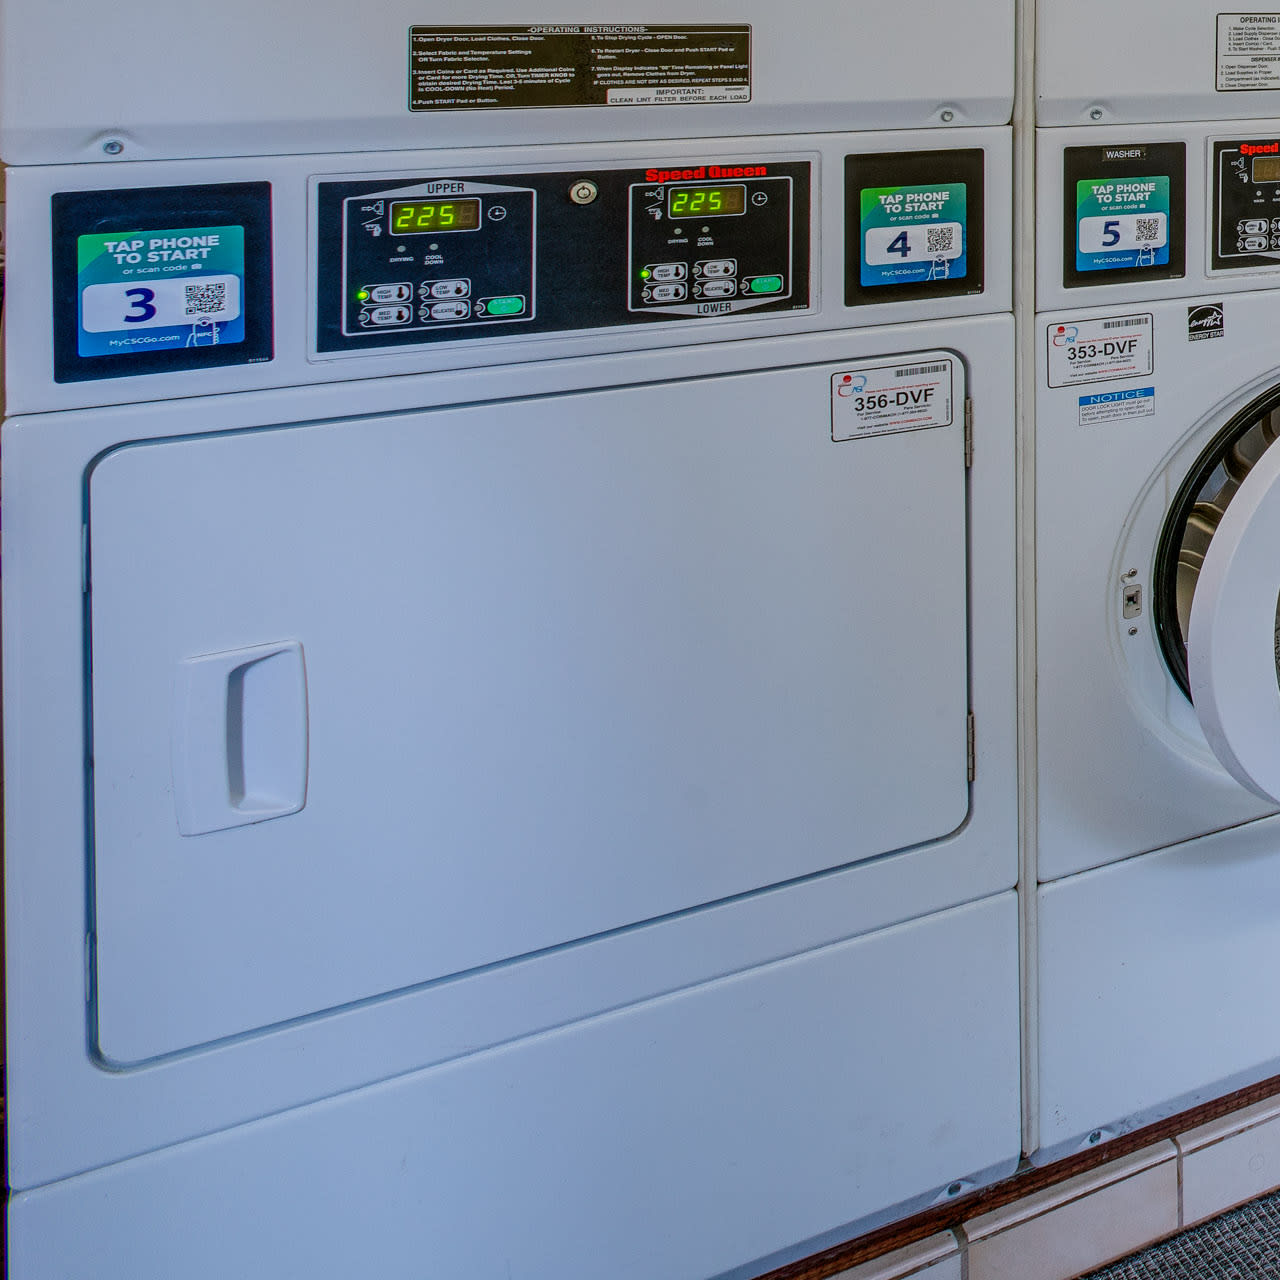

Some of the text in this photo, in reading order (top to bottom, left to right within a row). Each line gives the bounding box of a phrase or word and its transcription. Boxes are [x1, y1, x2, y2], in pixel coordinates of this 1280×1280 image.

[1107, 150, 1140, 159] WASHER
[1240, 143, 1278, 155] Speed
[645, 165, 767, 183] Speed Queen
[427, 182, 464, 194] UPPER
[1092, 183, 1156, 194] TAP PHONE
[673, 192, 721, 212] 225
[879, 191, 950, 204] TAP PHONE
[1096, 192, 1151, 203] TO START
[884, 201, 944, 213] TO START
[397, 205, 454, 228] 225
[1102, 220, 1120, 246] 5
[104, 235, 220, 253] TAP PHONE
[887, 231, 911, 257] 4
[114, 247, 211, 264] TO START
[137, 266, 160, 274] scan
[163, 264, 188, 272] code
[124, 287, 156, 323] 3
[697, 303, 732, 314] LOWER
[109, 334, 180, 346] MyCSCGo.com
[1189, 330, 1223, 341] ENERGY STAR
[1068, 340, 1138, 360] 353-DVF
[855, 388, 934, 411] 356-DVF
[1090, 390, 1145, 403] NOTICE
